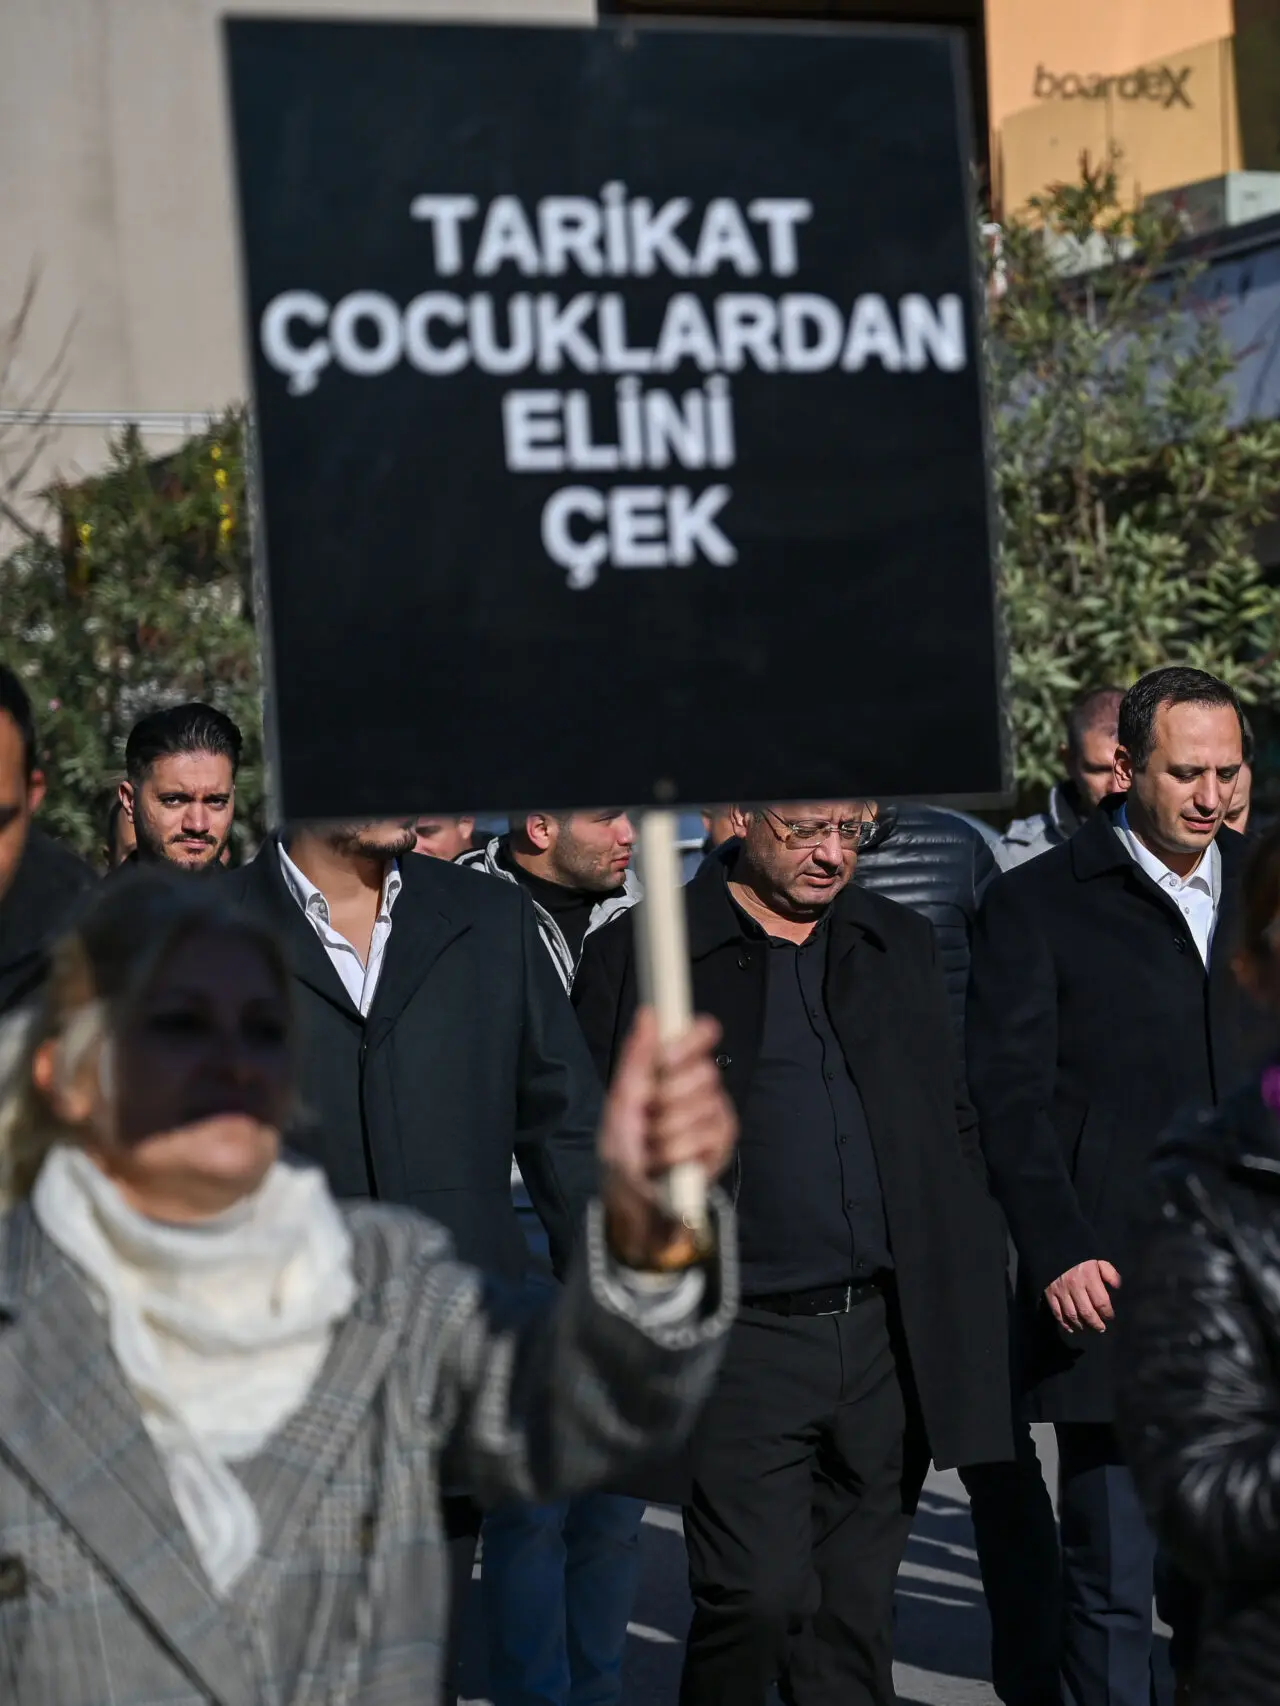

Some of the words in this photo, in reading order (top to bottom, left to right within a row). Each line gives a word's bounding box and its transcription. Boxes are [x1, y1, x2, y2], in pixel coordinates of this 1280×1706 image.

[411, 181, 812, 277] TARİKAT
[261, 292, 967, 395] ÇOCUKLARDAN
[502, 374, 735, 471] ELİNİ
[541, 485, 736, 588] ÇEK
